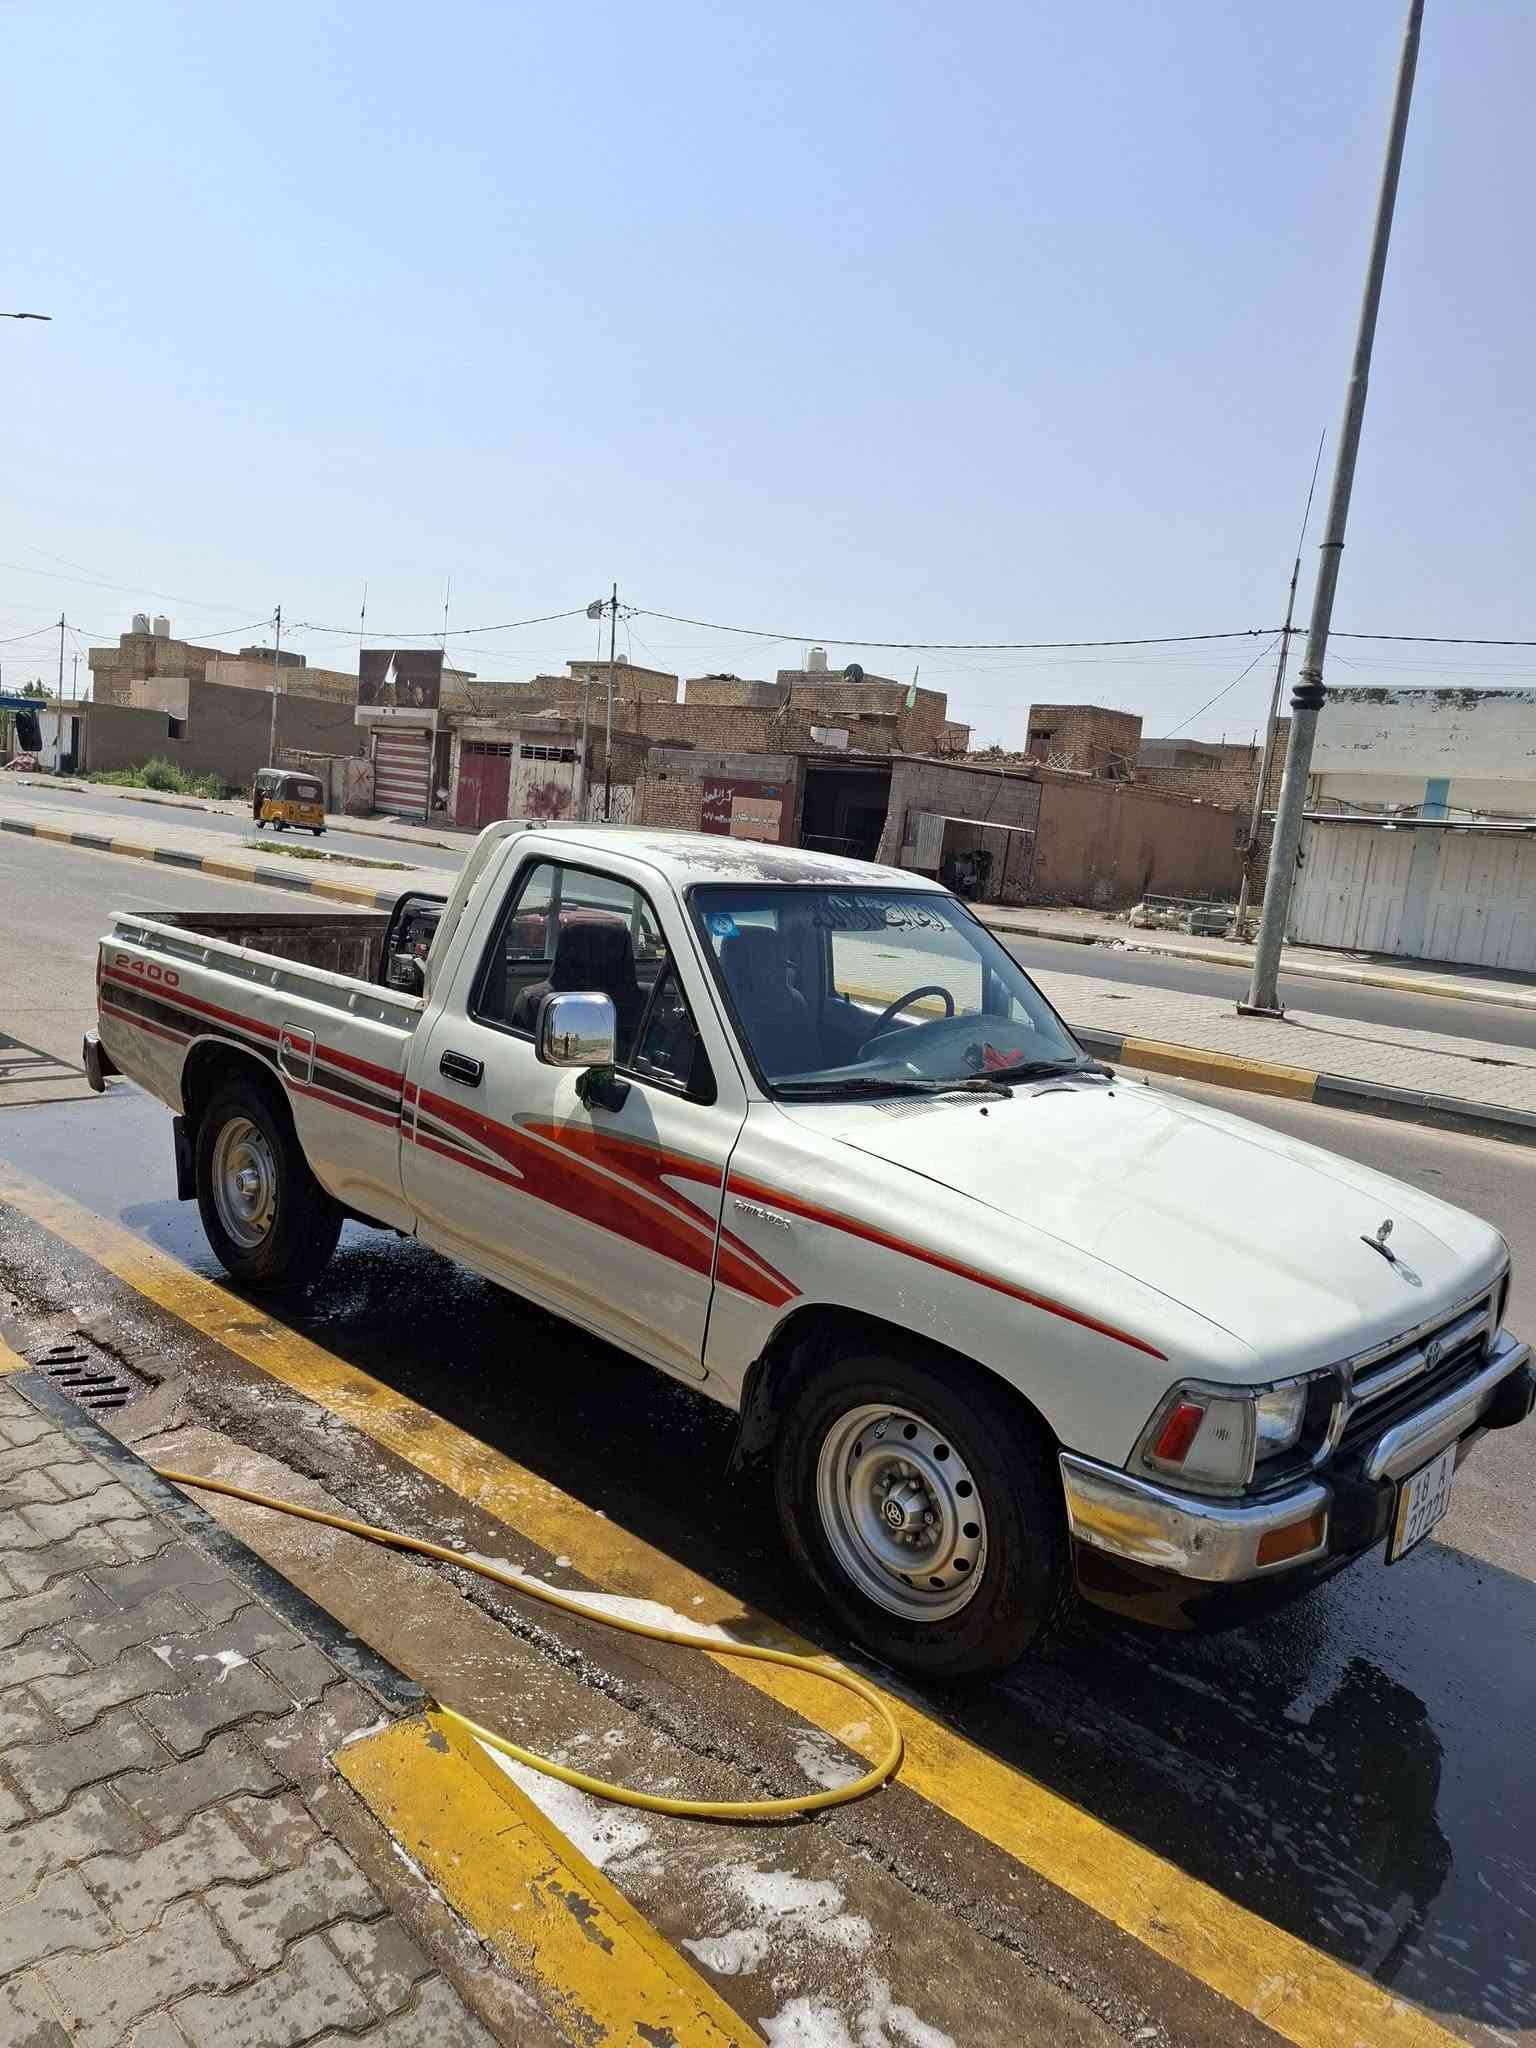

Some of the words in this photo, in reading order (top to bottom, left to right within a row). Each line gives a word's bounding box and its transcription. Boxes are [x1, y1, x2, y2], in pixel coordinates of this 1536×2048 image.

[114, 953, 180, 987] 2400
[1412, 1471, 1431, 1511] 18
[1438, 1457, 1448, 1486] A
